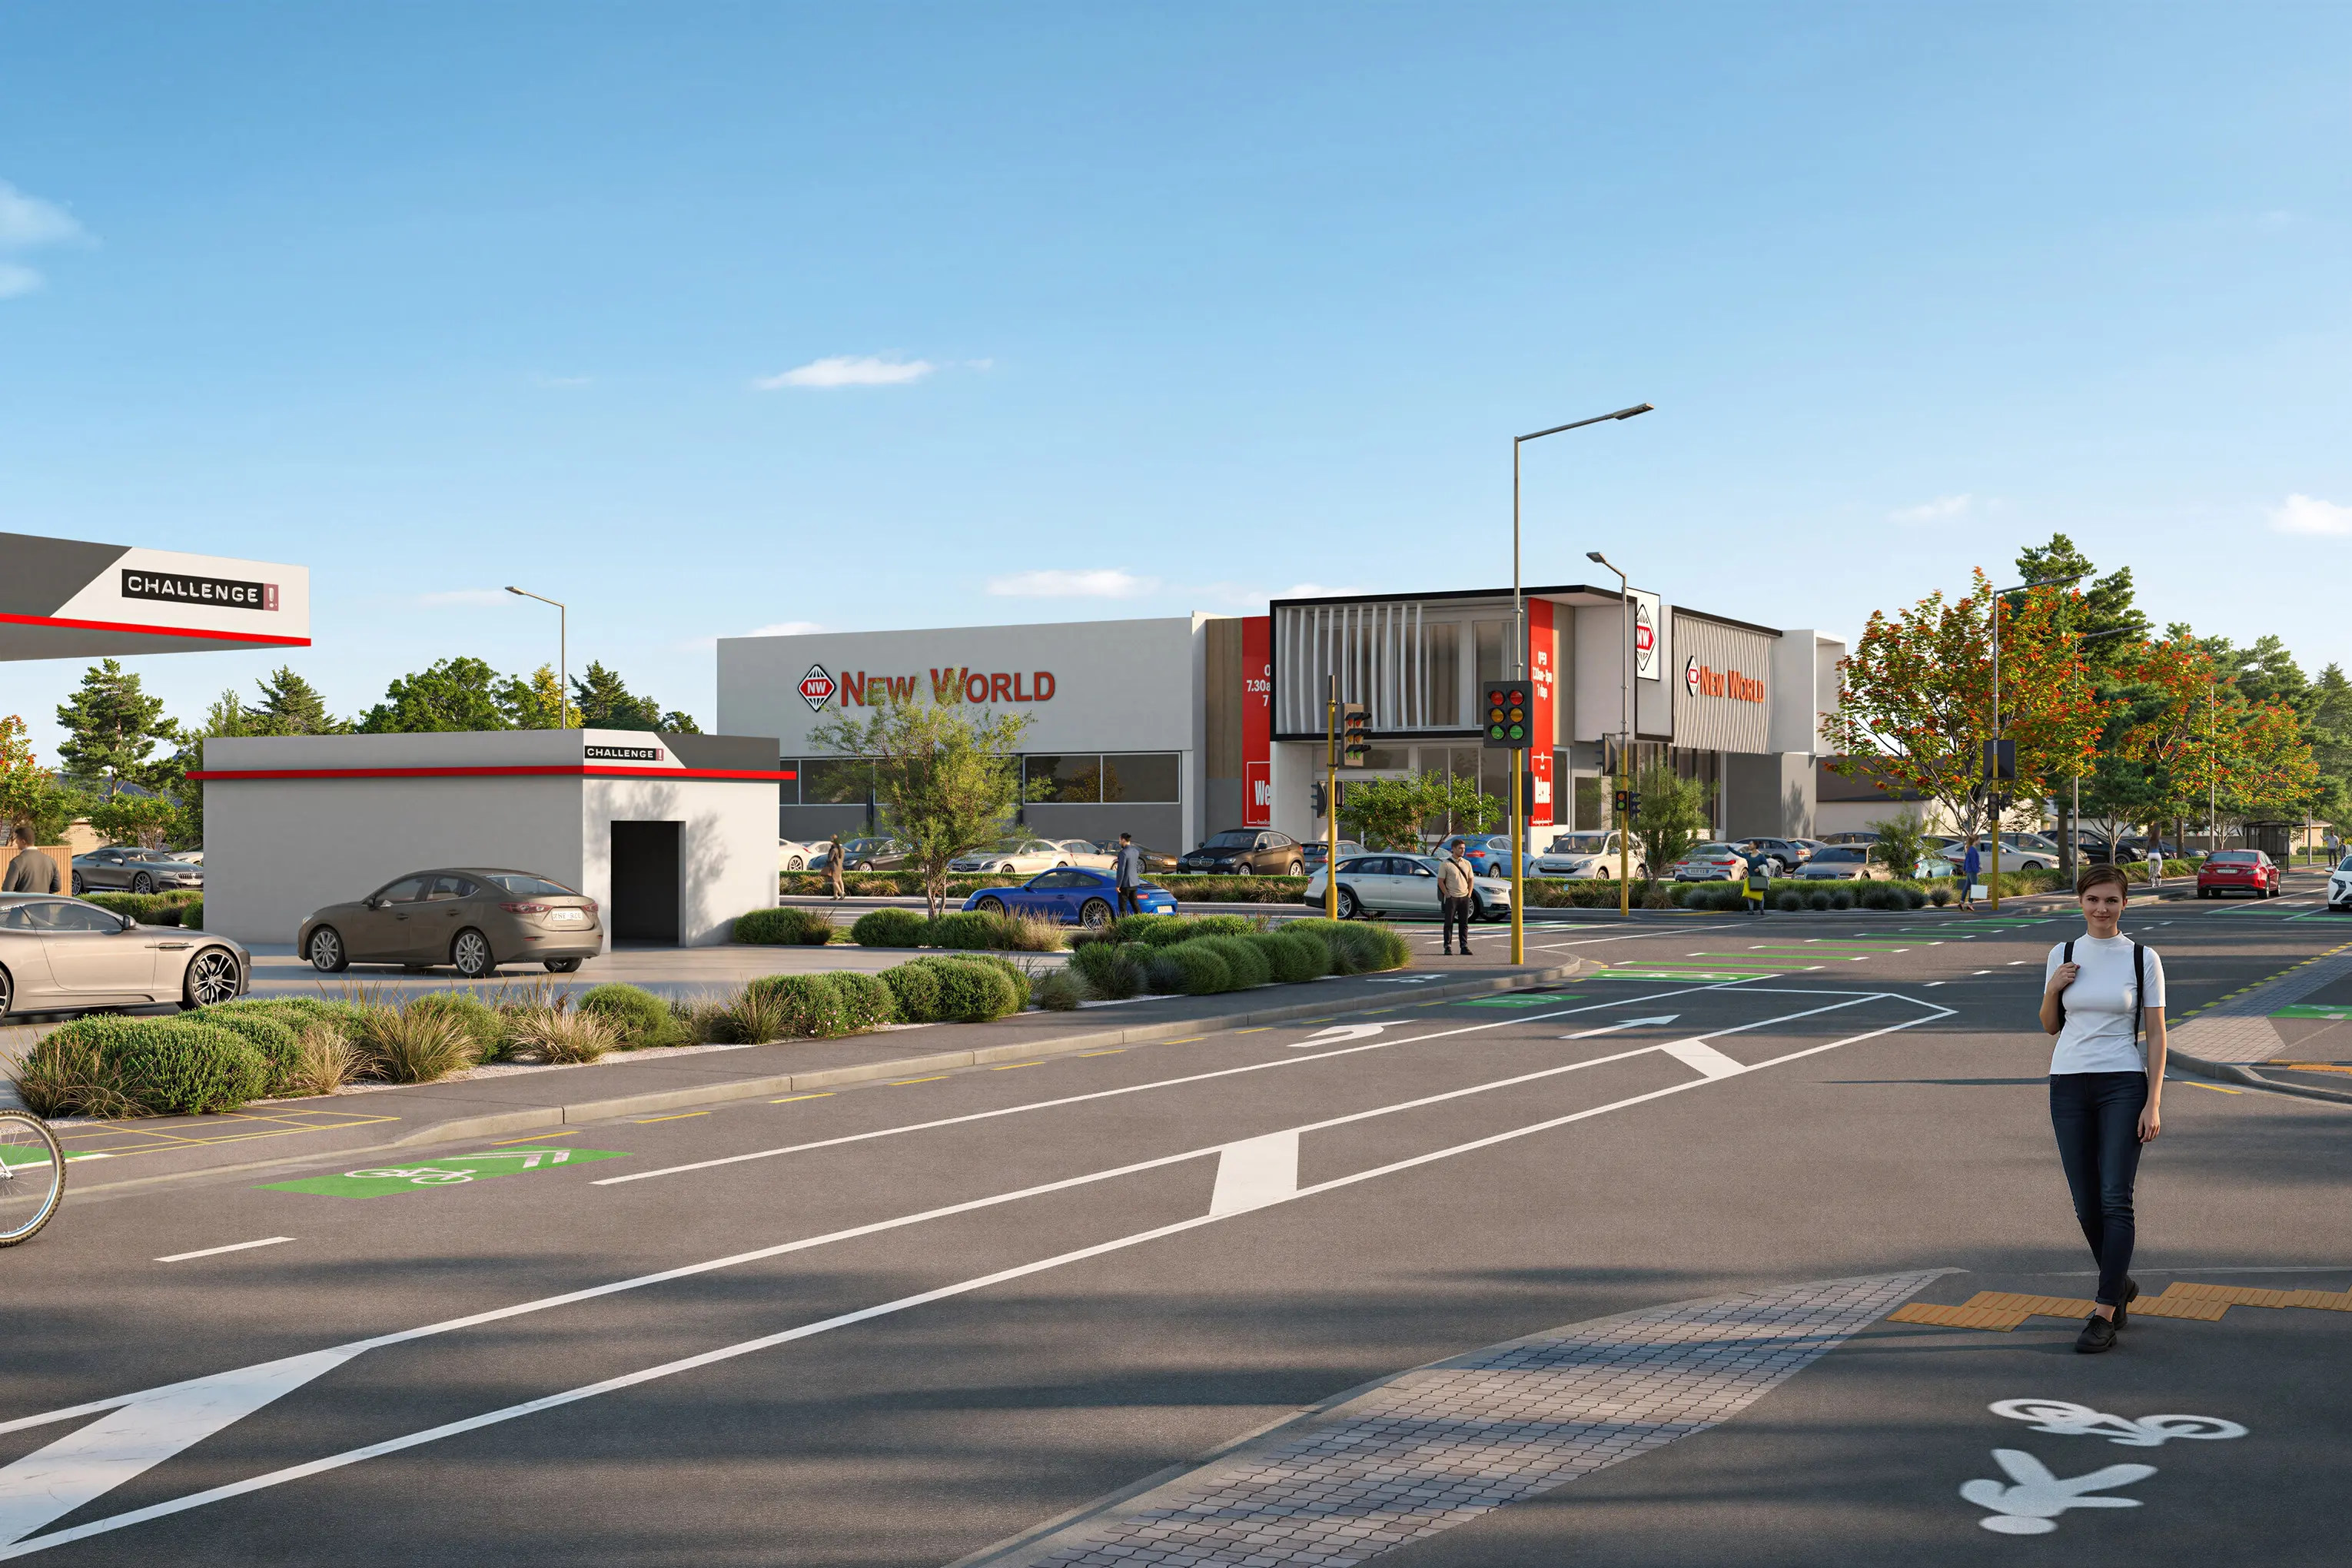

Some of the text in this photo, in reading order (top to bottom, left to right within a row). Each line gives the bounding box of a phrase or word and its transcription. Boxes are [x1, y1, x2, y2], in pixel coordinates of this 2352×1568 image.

[807, 681, 827, 694] NW
[930, 667, 1055, 704] WORLD
[1699, 665, 1765, 703] NEW WORLD
[1263, 694, 1269, 706] 7
